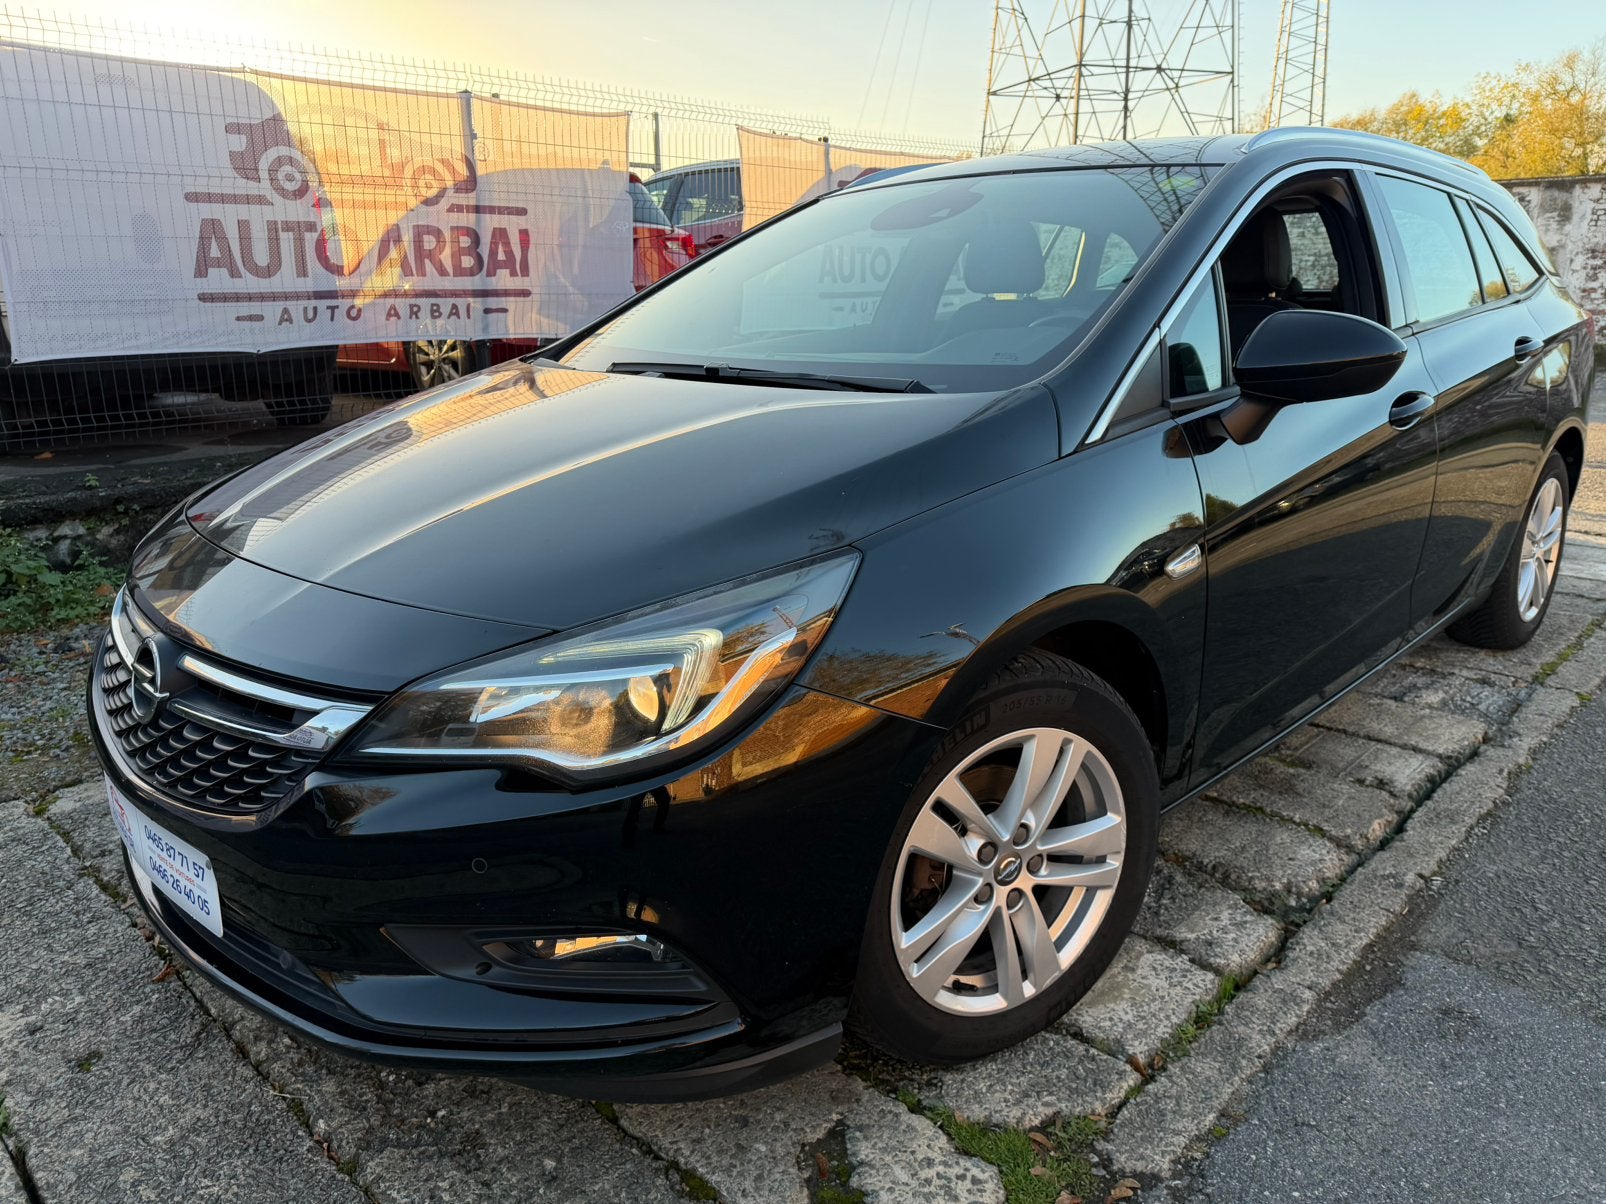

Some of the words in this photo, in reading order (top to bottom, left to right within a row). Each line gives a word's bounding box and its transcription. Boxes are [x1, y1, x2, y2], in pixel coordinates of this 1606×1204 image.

[194, 218, 363, 278] AUTO
[375, 223, 530, 278] ARBAI
[818, 246, 891, 283] AUTO
[278, 304, 362, 325] AUTO
[385, 302, 471, 321] ARBAI
[851, 301, 877, 315] AUT
[144, 825, 164, 852] 0465
[165, 842, 176, 861] 87
[177, 851, 190, 872] 71
[192, 861, 205, 881] 57
[149, 856, 169, 884] 0466
[169, 874, 182, 894] 26
[183, 885, 196, 905] 40
[197, 894, 210, 916] 05
